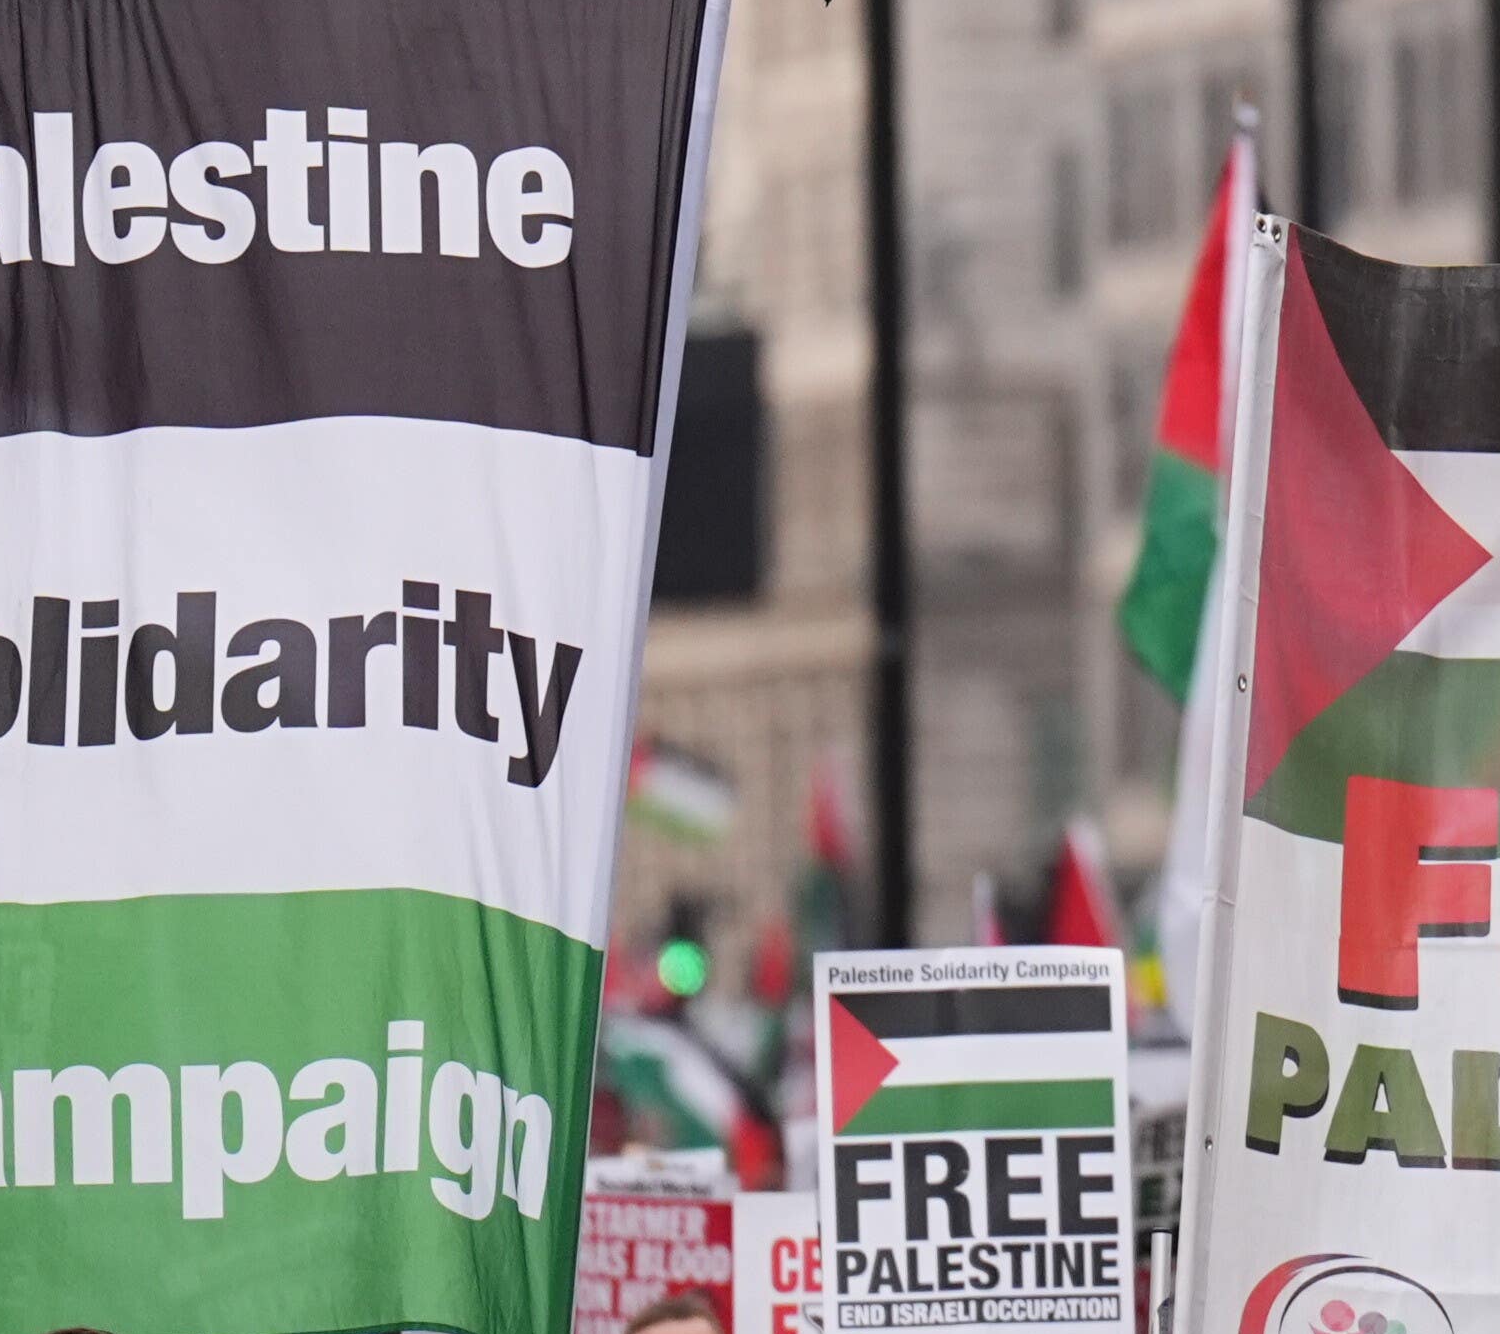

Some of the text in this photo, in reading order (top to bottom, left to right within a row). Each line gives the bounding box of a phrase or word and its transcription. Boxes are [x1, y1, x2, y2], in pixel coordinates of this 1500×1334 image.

[828, 959, 1110, 984] Palestine Solidarity Campaign
[833, 1135, 1119, 1243] FREE
[633, 1242, 731, 1283] BLOOD
[836, 1241, 1120, 1295] PALESTINE
[840, 1295, 1119, 1326] END ISRAELI OCCUPATION
